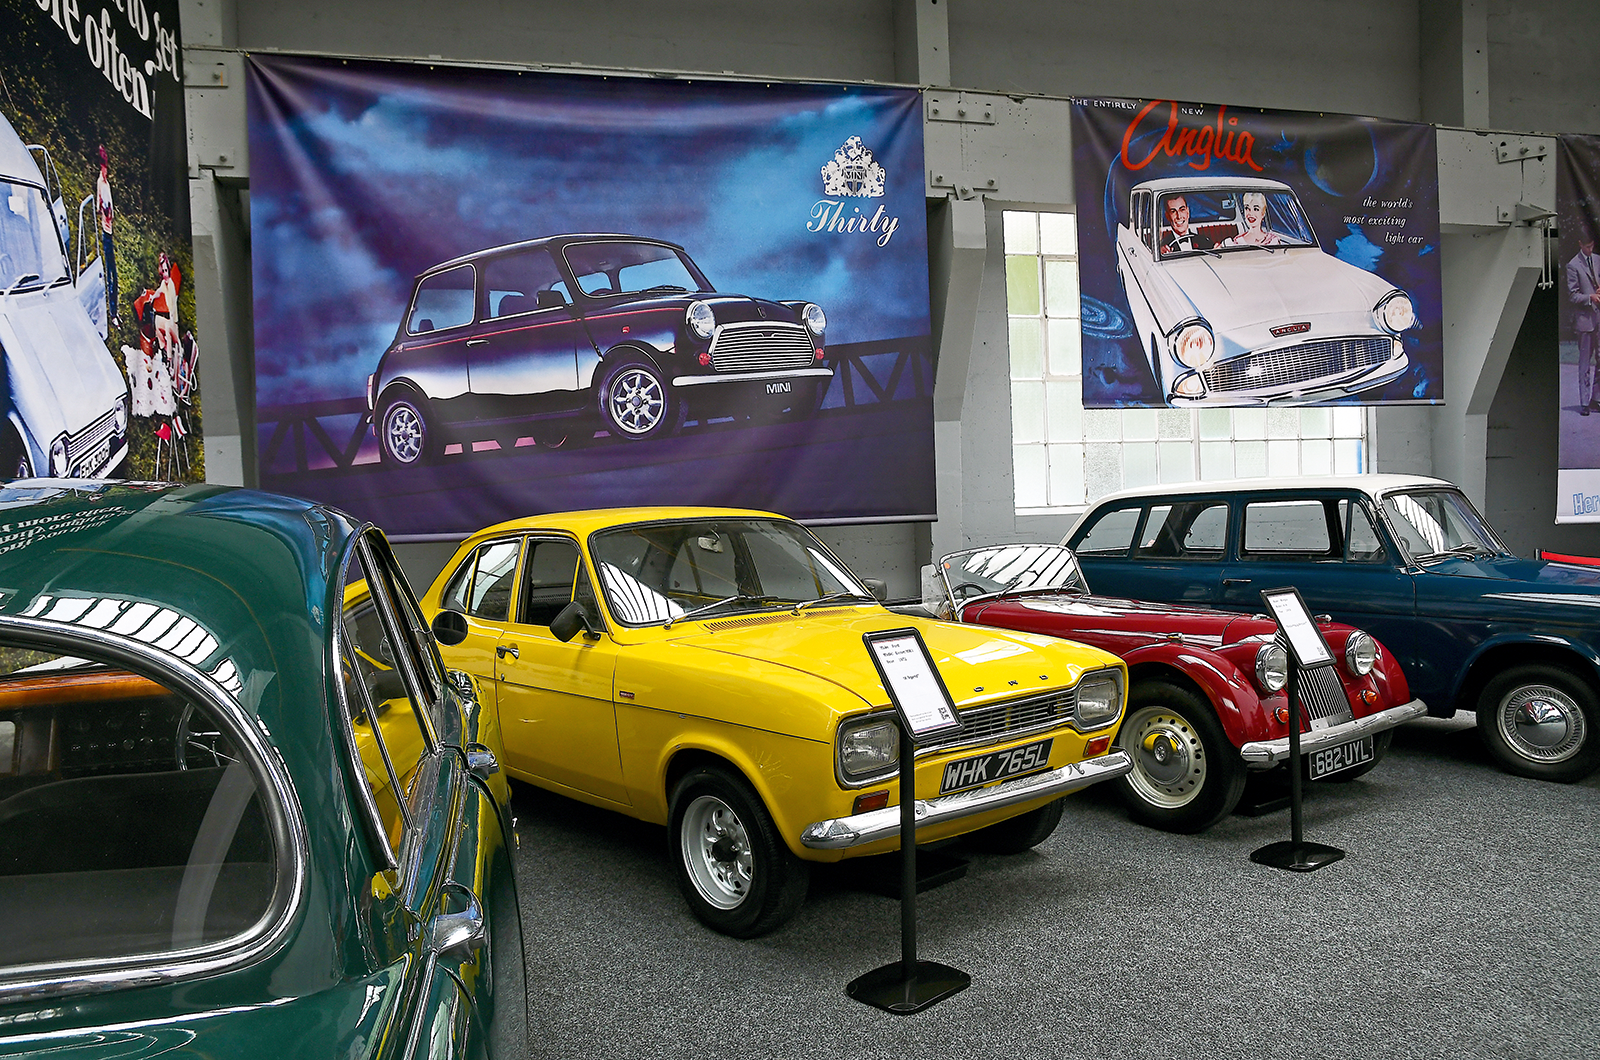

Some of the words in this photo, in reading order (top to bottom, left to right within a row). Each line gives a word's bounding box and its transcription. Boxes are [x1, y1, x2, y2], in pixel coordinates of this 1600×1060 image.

[1070, 98, 1088, 106] THE
[1093, 100, 1138, 110] ENTIRELY
[1181, 107, 1205, 116] NEW
[1120, 98, 1264, 172] Anglia
[1362, 196, 1378, 208] the
[1381, 197, 1414, 209] world's
[806, 199, 900, 247] Thirty
[1343, 214, 1365, 225] most
[1368, 215, 1407, 228] exciting
[1385, 231, 1405, 245] light
[1407, 236, 1424, 244] car
[766, 382, 792, 394] MINI
[1572, 492, 1600, 516] Her
[974, 675, 1048, 692] ORD
[1316, 746, 1343, 775] 682
[1344, 740, 1369, 765] UYL
[945, 756, 993, 790] WHK
[995, 744, 1047, 778] 765L
